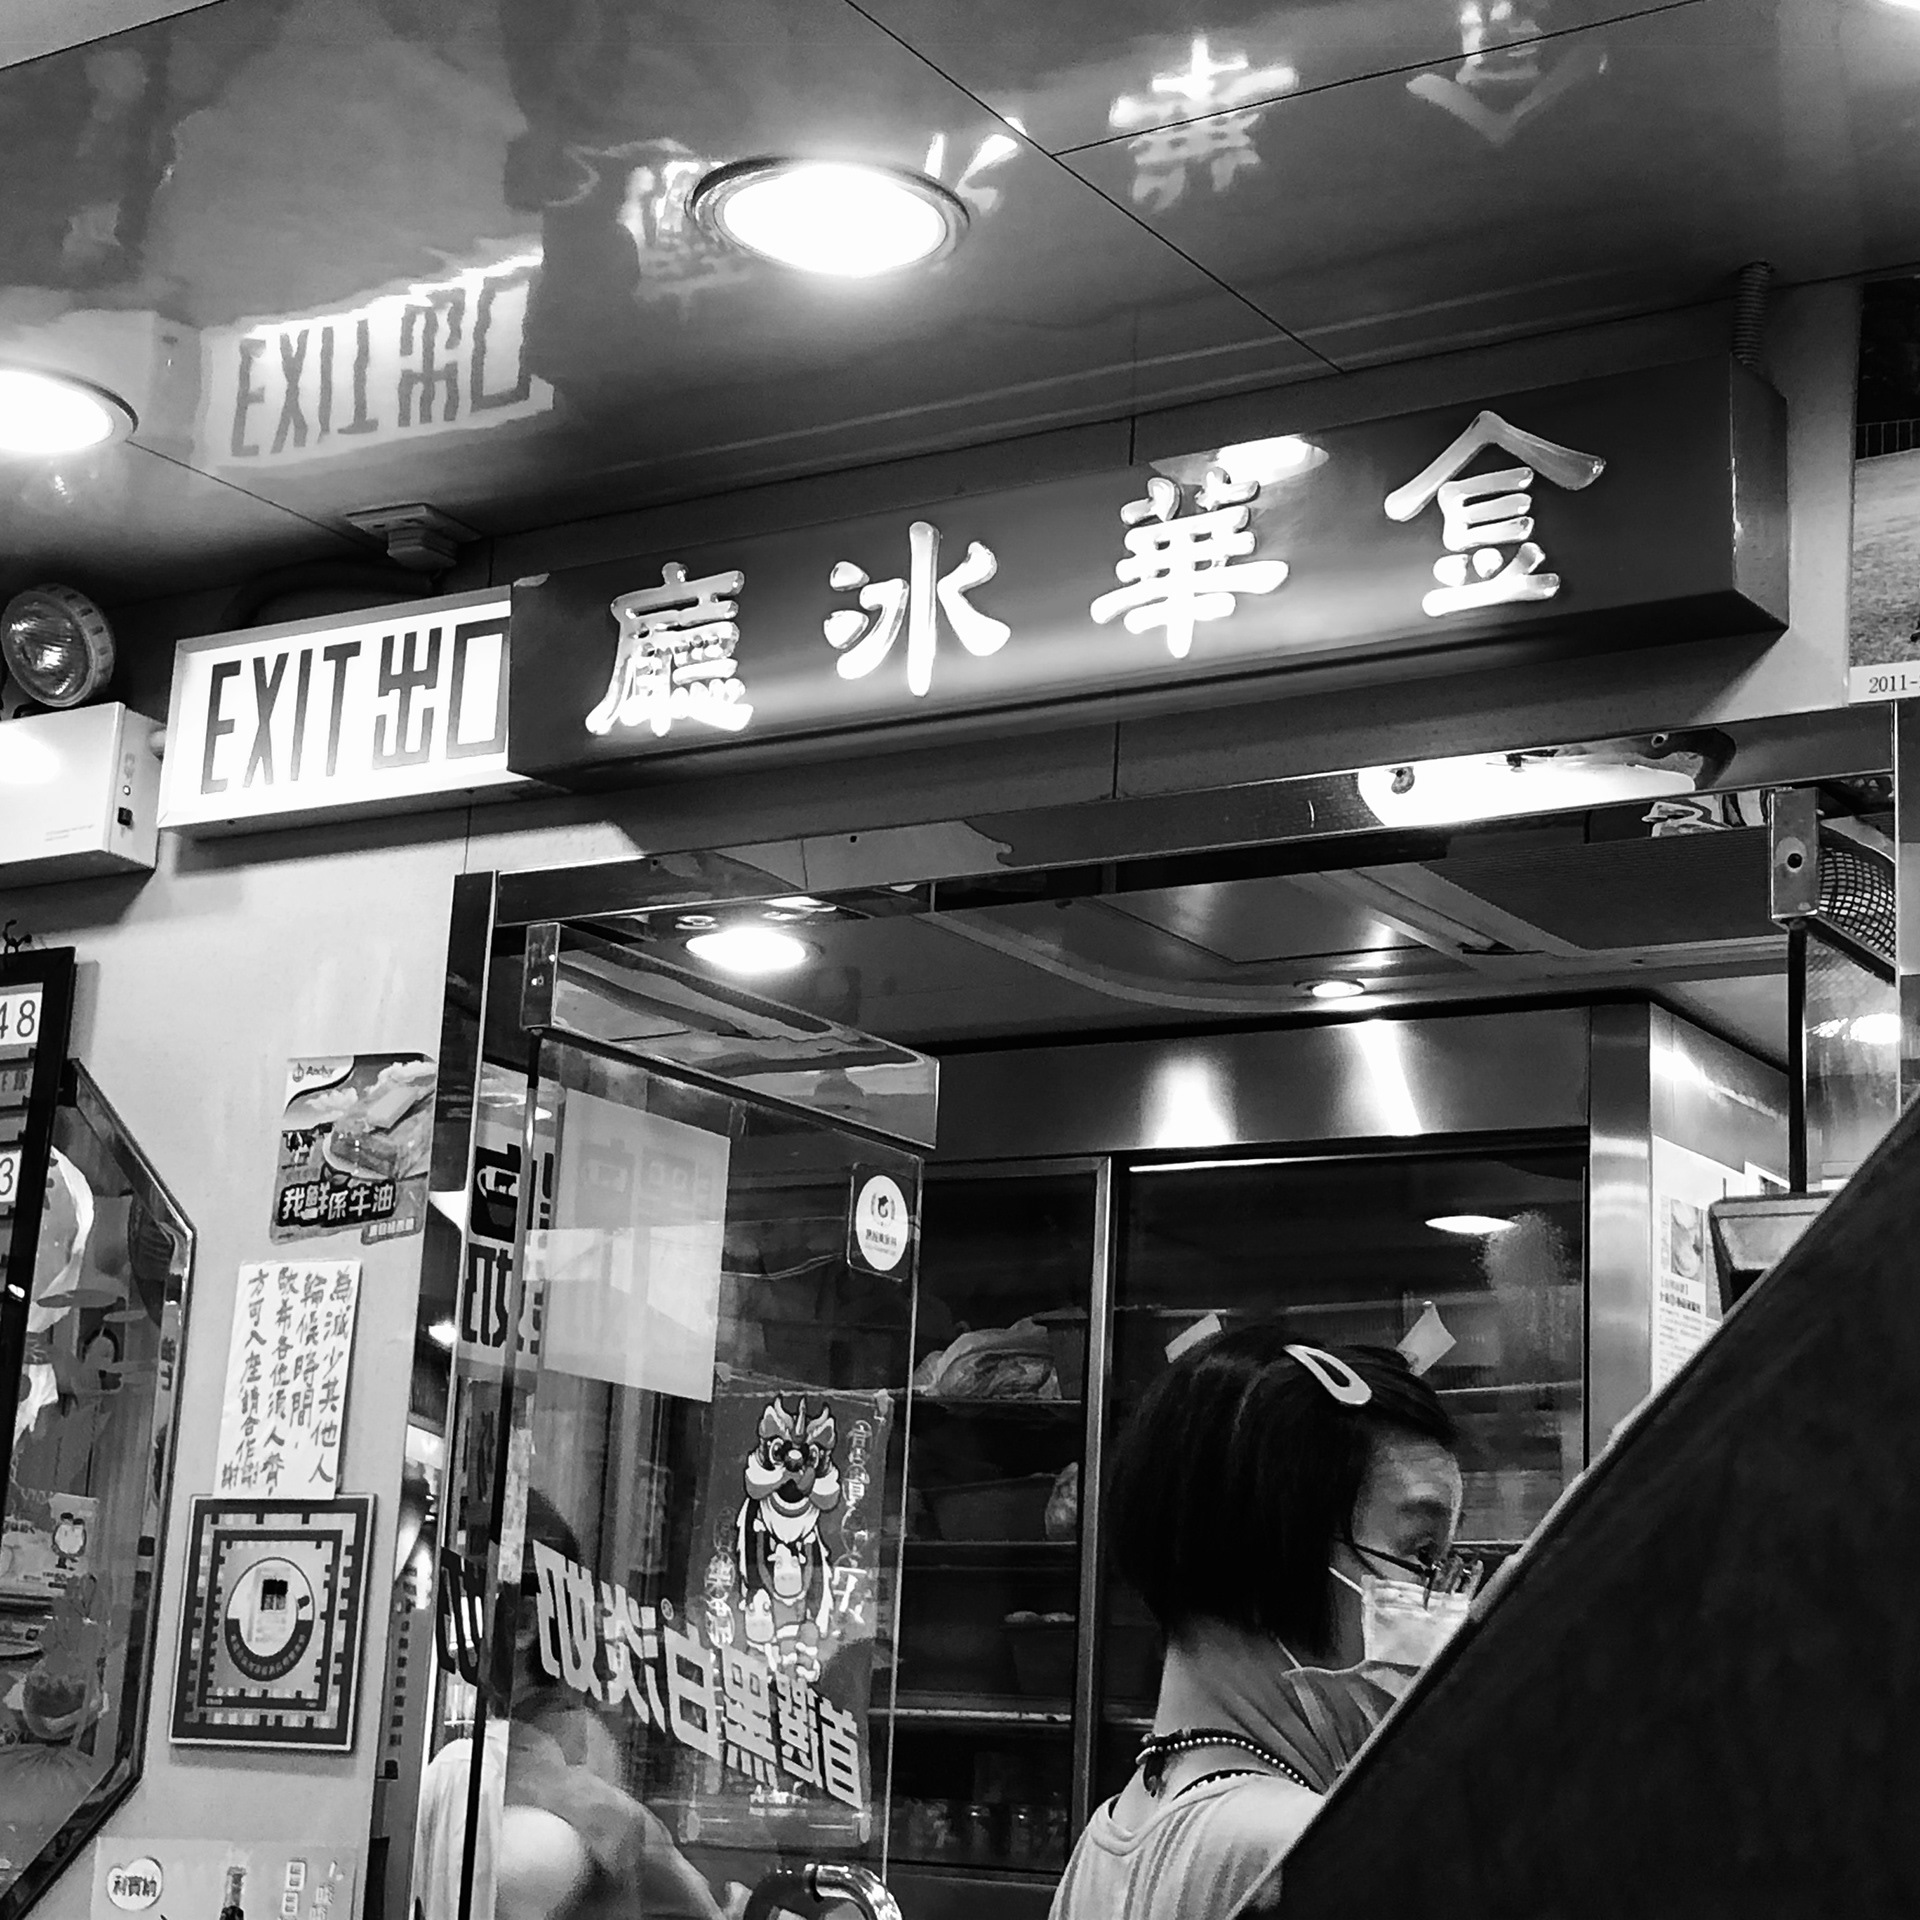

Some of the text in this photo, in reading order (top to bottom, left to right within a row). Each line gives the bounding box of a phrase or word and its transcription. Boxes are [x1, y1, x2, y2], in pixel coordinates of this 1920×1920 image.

[201, 617, 512, 795] EXIT 出口
[1868, 674, 1920, 694] 2011-
